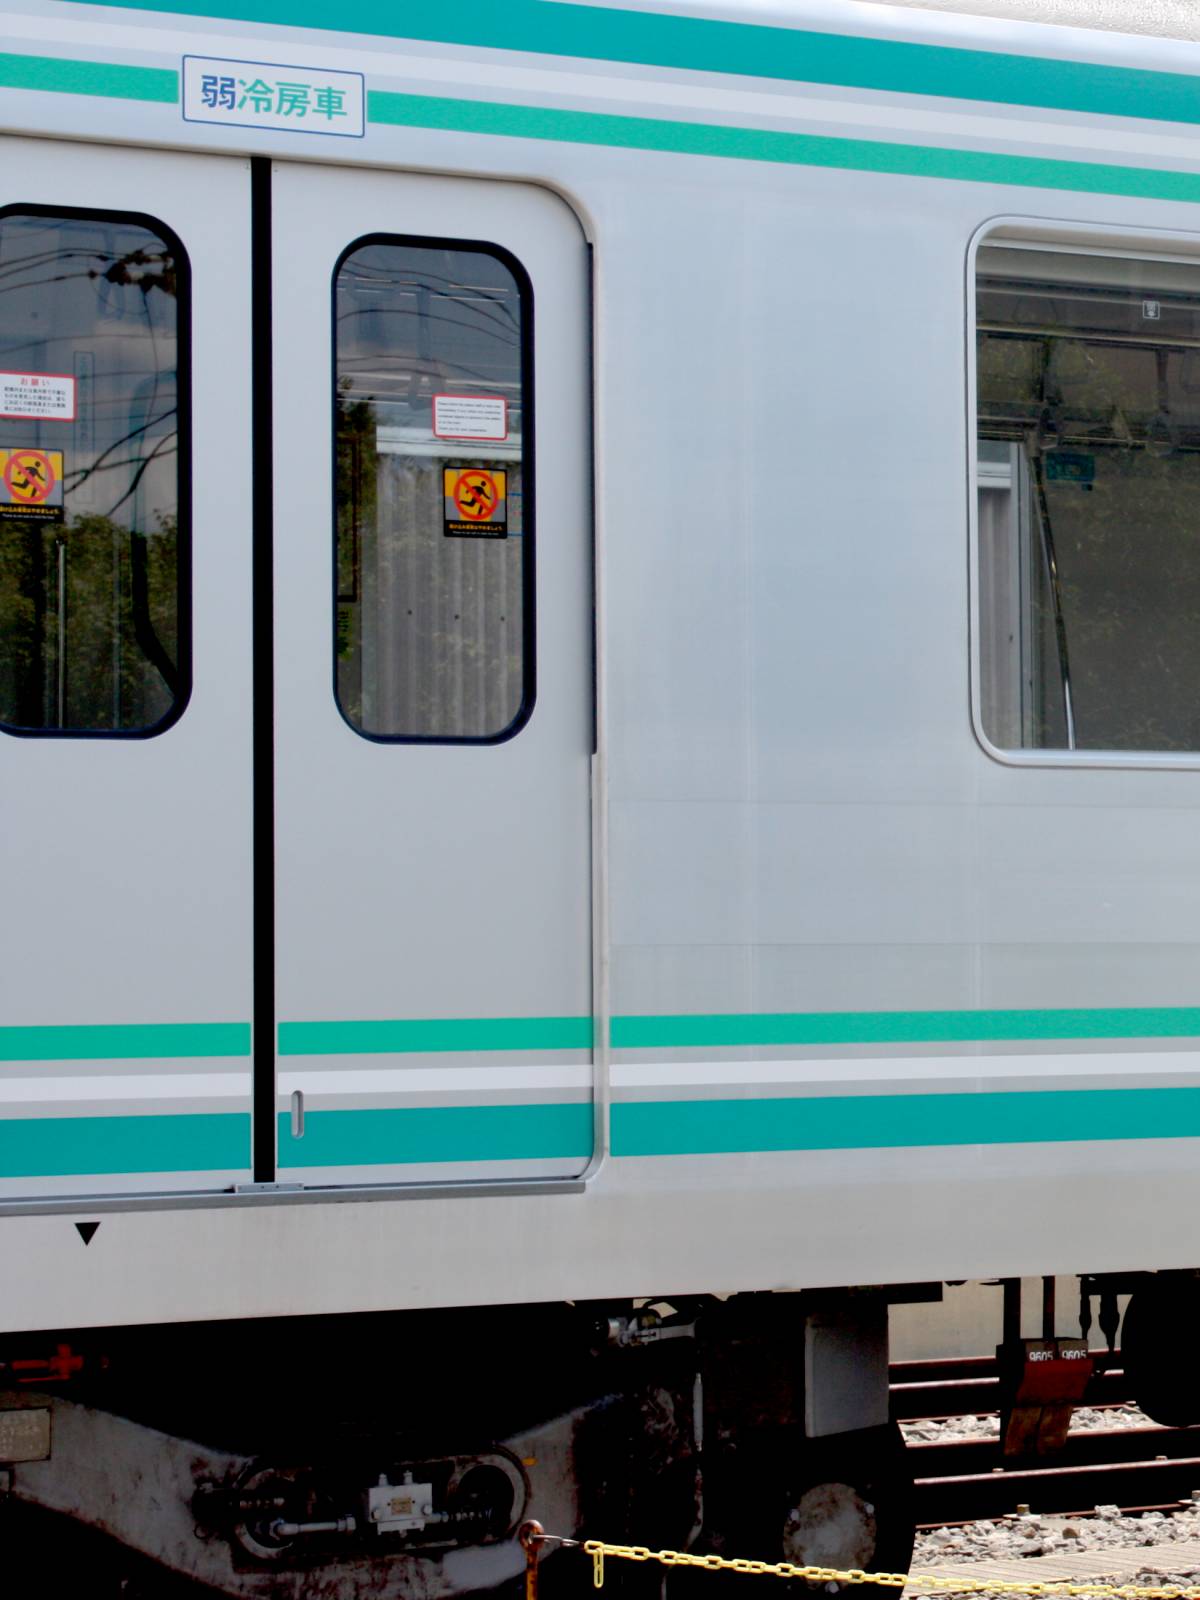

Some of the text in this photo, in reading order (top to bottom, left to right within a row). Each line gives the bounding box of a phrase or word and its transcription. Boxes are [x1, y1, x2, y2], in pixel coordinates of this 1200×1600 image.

[201, 74, 348, 121] 弱冷房車
[1029, 1351, 1054, 1362] 9605
[1062, 1350, 1087, 1360] 9605
